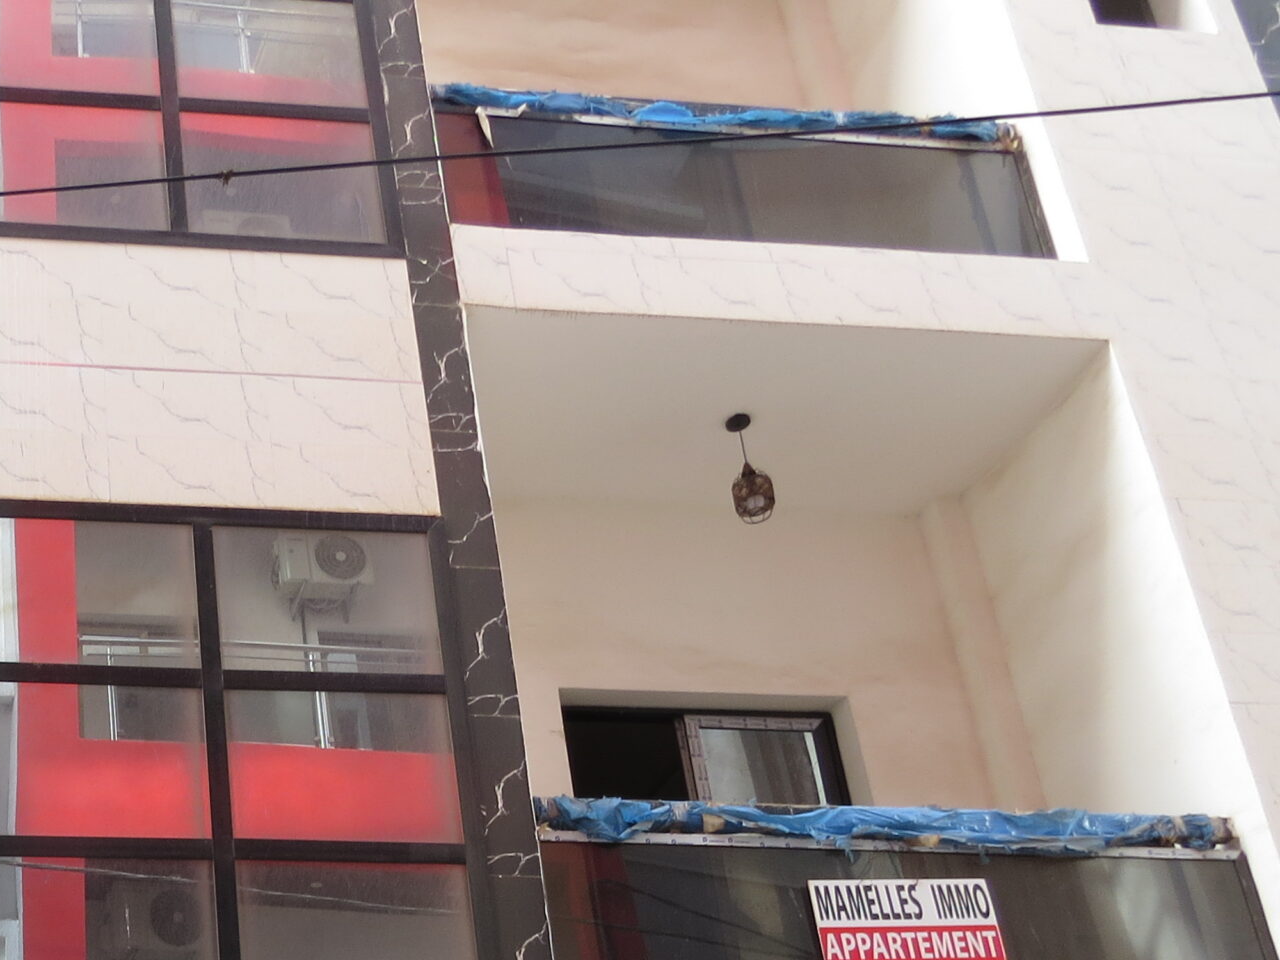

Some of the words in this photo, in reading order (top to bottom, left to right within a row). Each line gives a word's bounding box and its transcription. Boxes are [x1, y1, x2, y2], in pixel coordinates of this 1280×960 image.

[814, 884, 923, 921] MAMELLES
[931, 883, 990, 919] IMMO
[826, 930, 997, 960] APPARTEMENT
